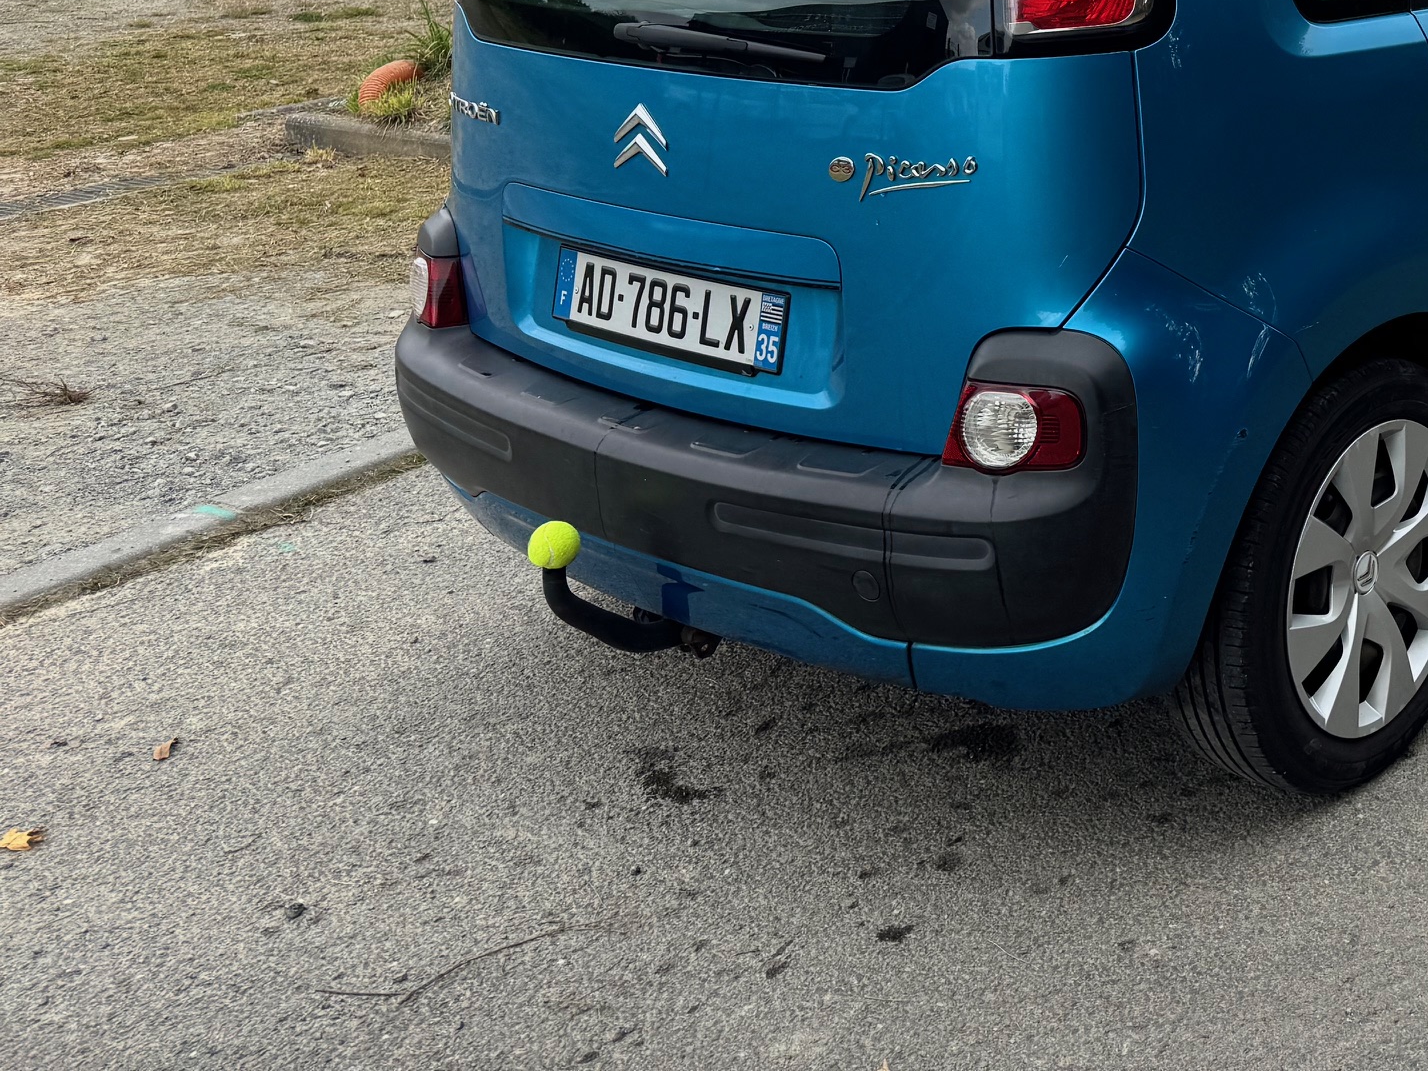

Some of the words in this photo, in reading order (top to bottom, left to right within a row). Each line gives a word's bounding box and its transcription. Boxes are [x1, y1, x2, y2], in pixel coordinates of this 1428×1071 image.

[859, 152, 979, 202] Picasso
[560, 290, 568, 305] F
[577, 261, 751, 354] AD-786-LX
[756, 333, 779, 364] 35
